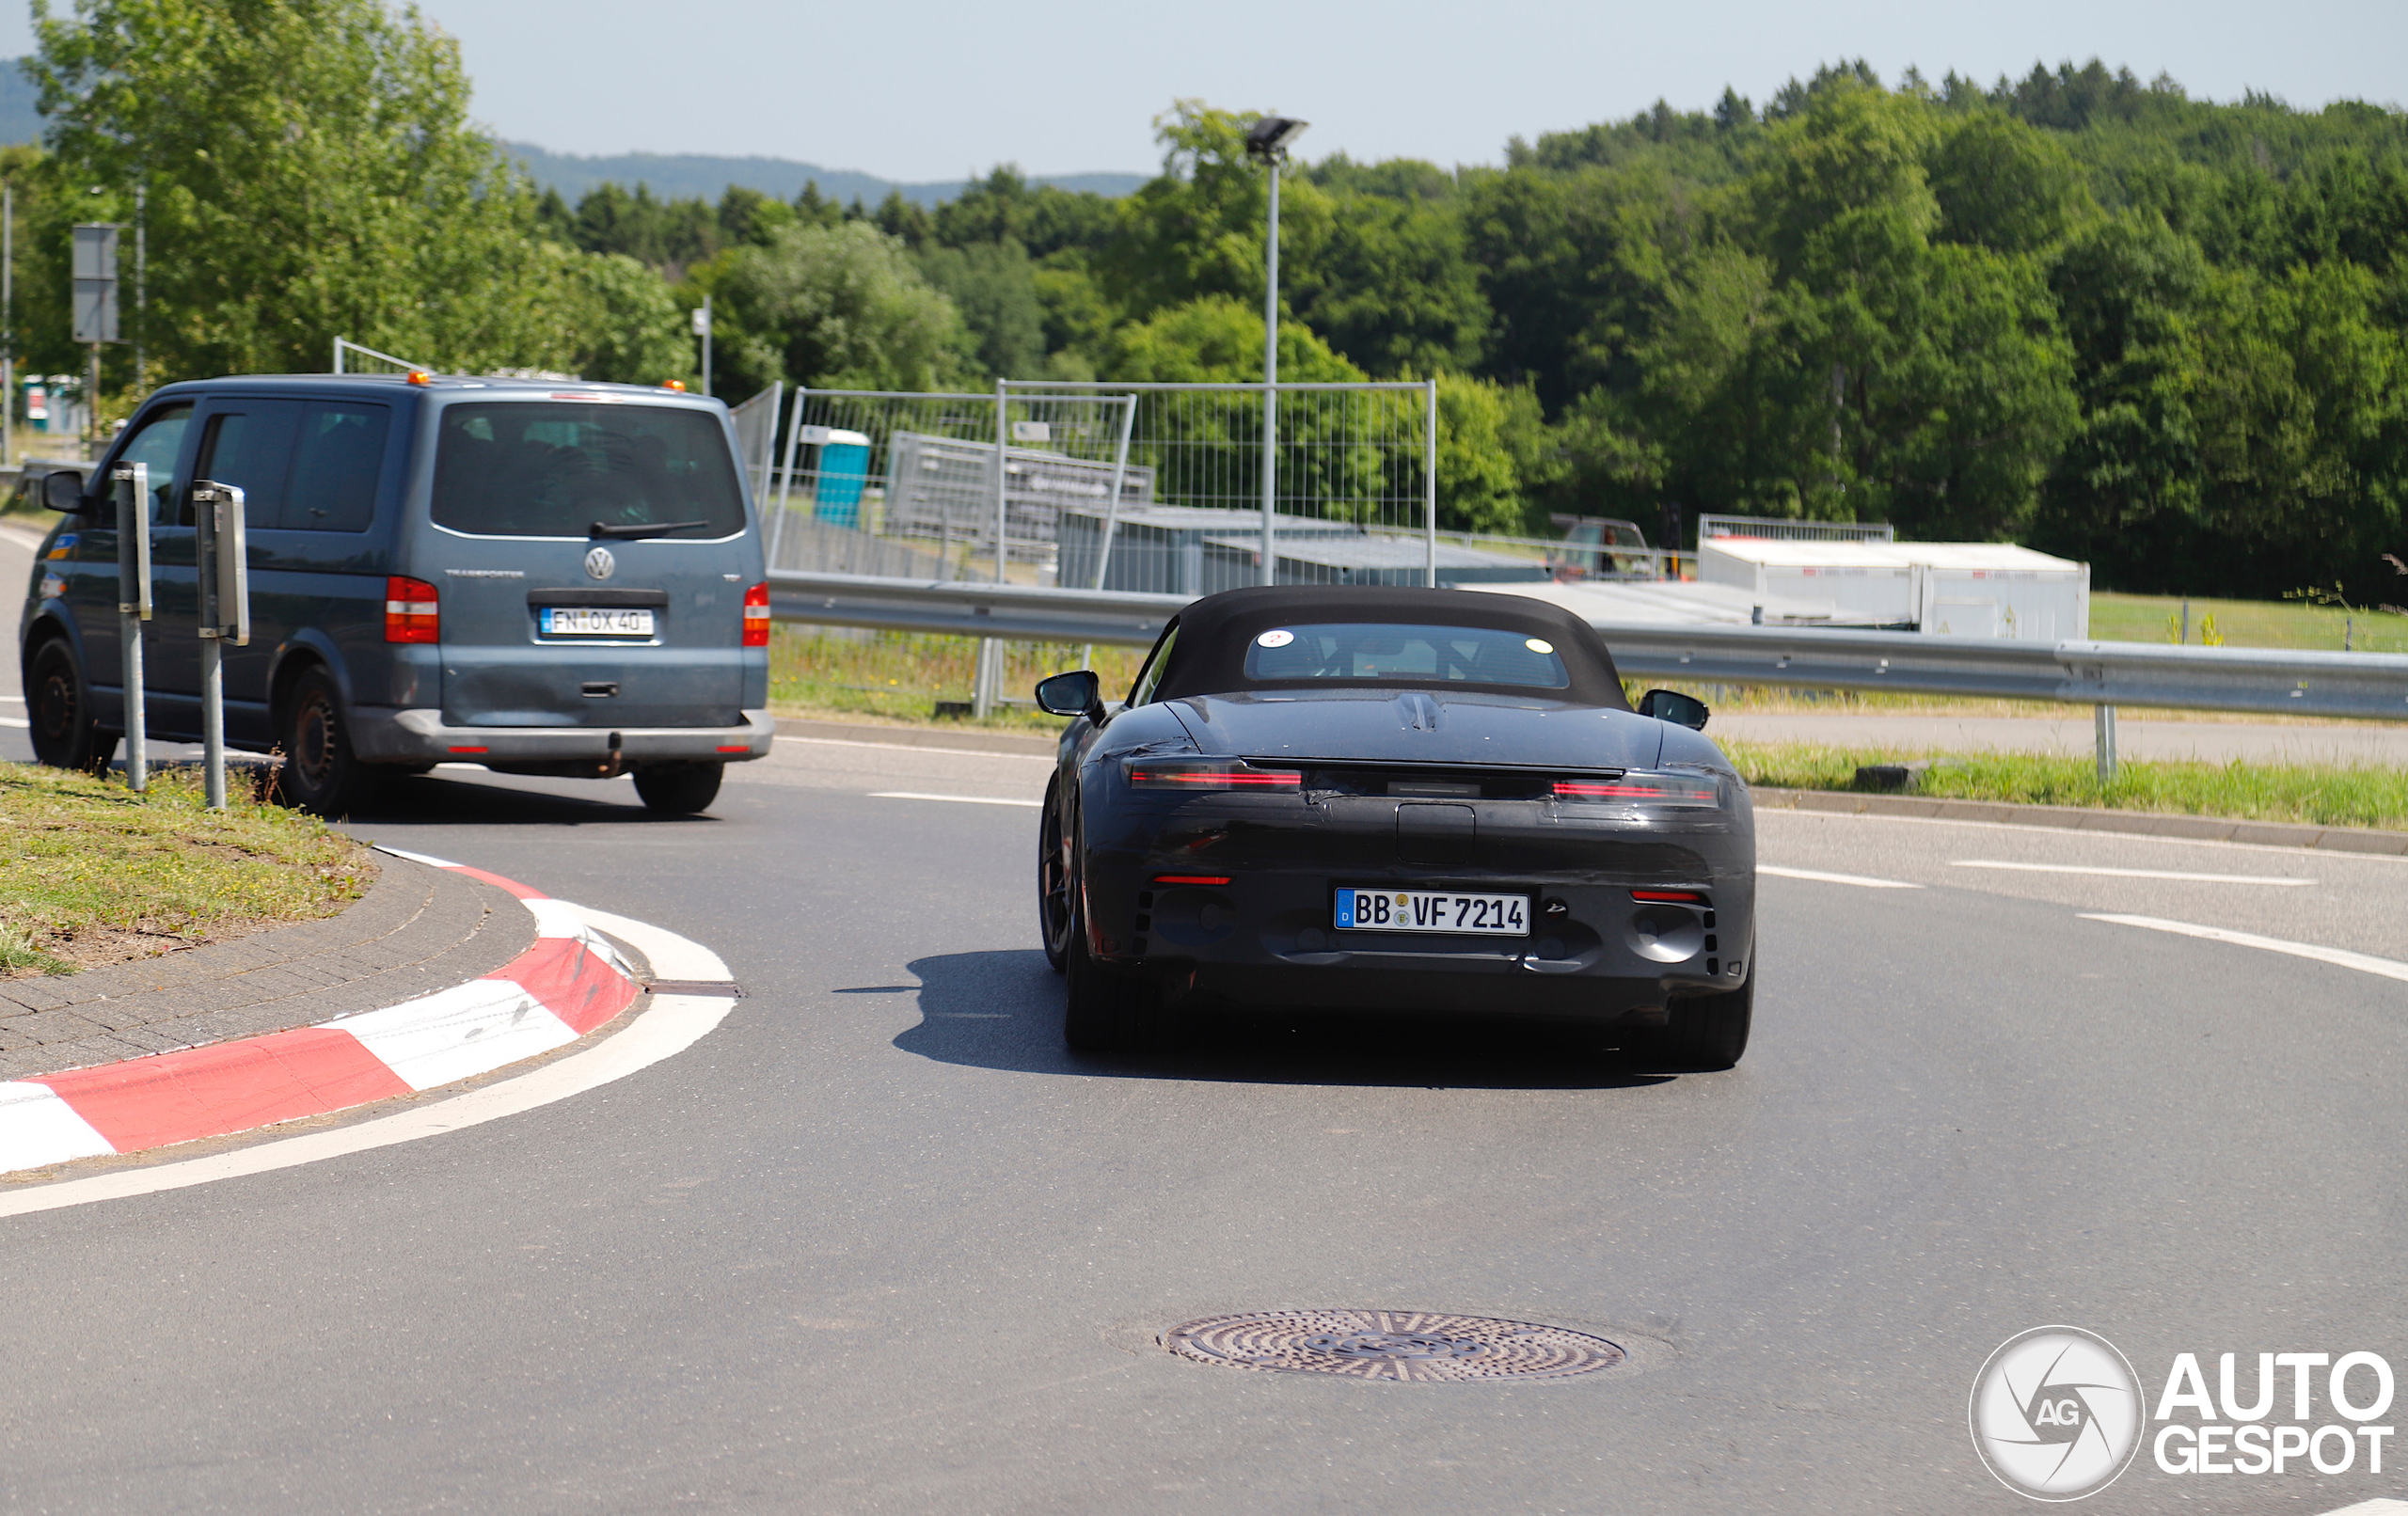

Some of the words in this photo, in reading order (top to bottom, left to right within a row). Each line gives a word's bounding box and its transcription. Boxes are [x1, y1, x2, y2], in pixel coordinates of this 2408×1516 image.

[444, 568, 526, 579] TRANSPORTER
[553, 611, 578, 630] FN
[590, 611, 614, 631] OX
[619, 612, 640, 631] 40
[1270, 634, 1281, 643] 2
[1341, 912, 1349, 922] D
[1355, 894, 1390, 924] BB
[1414, 896, 1448, 926] VF
[1455, 898, 1523, 929] 7214
